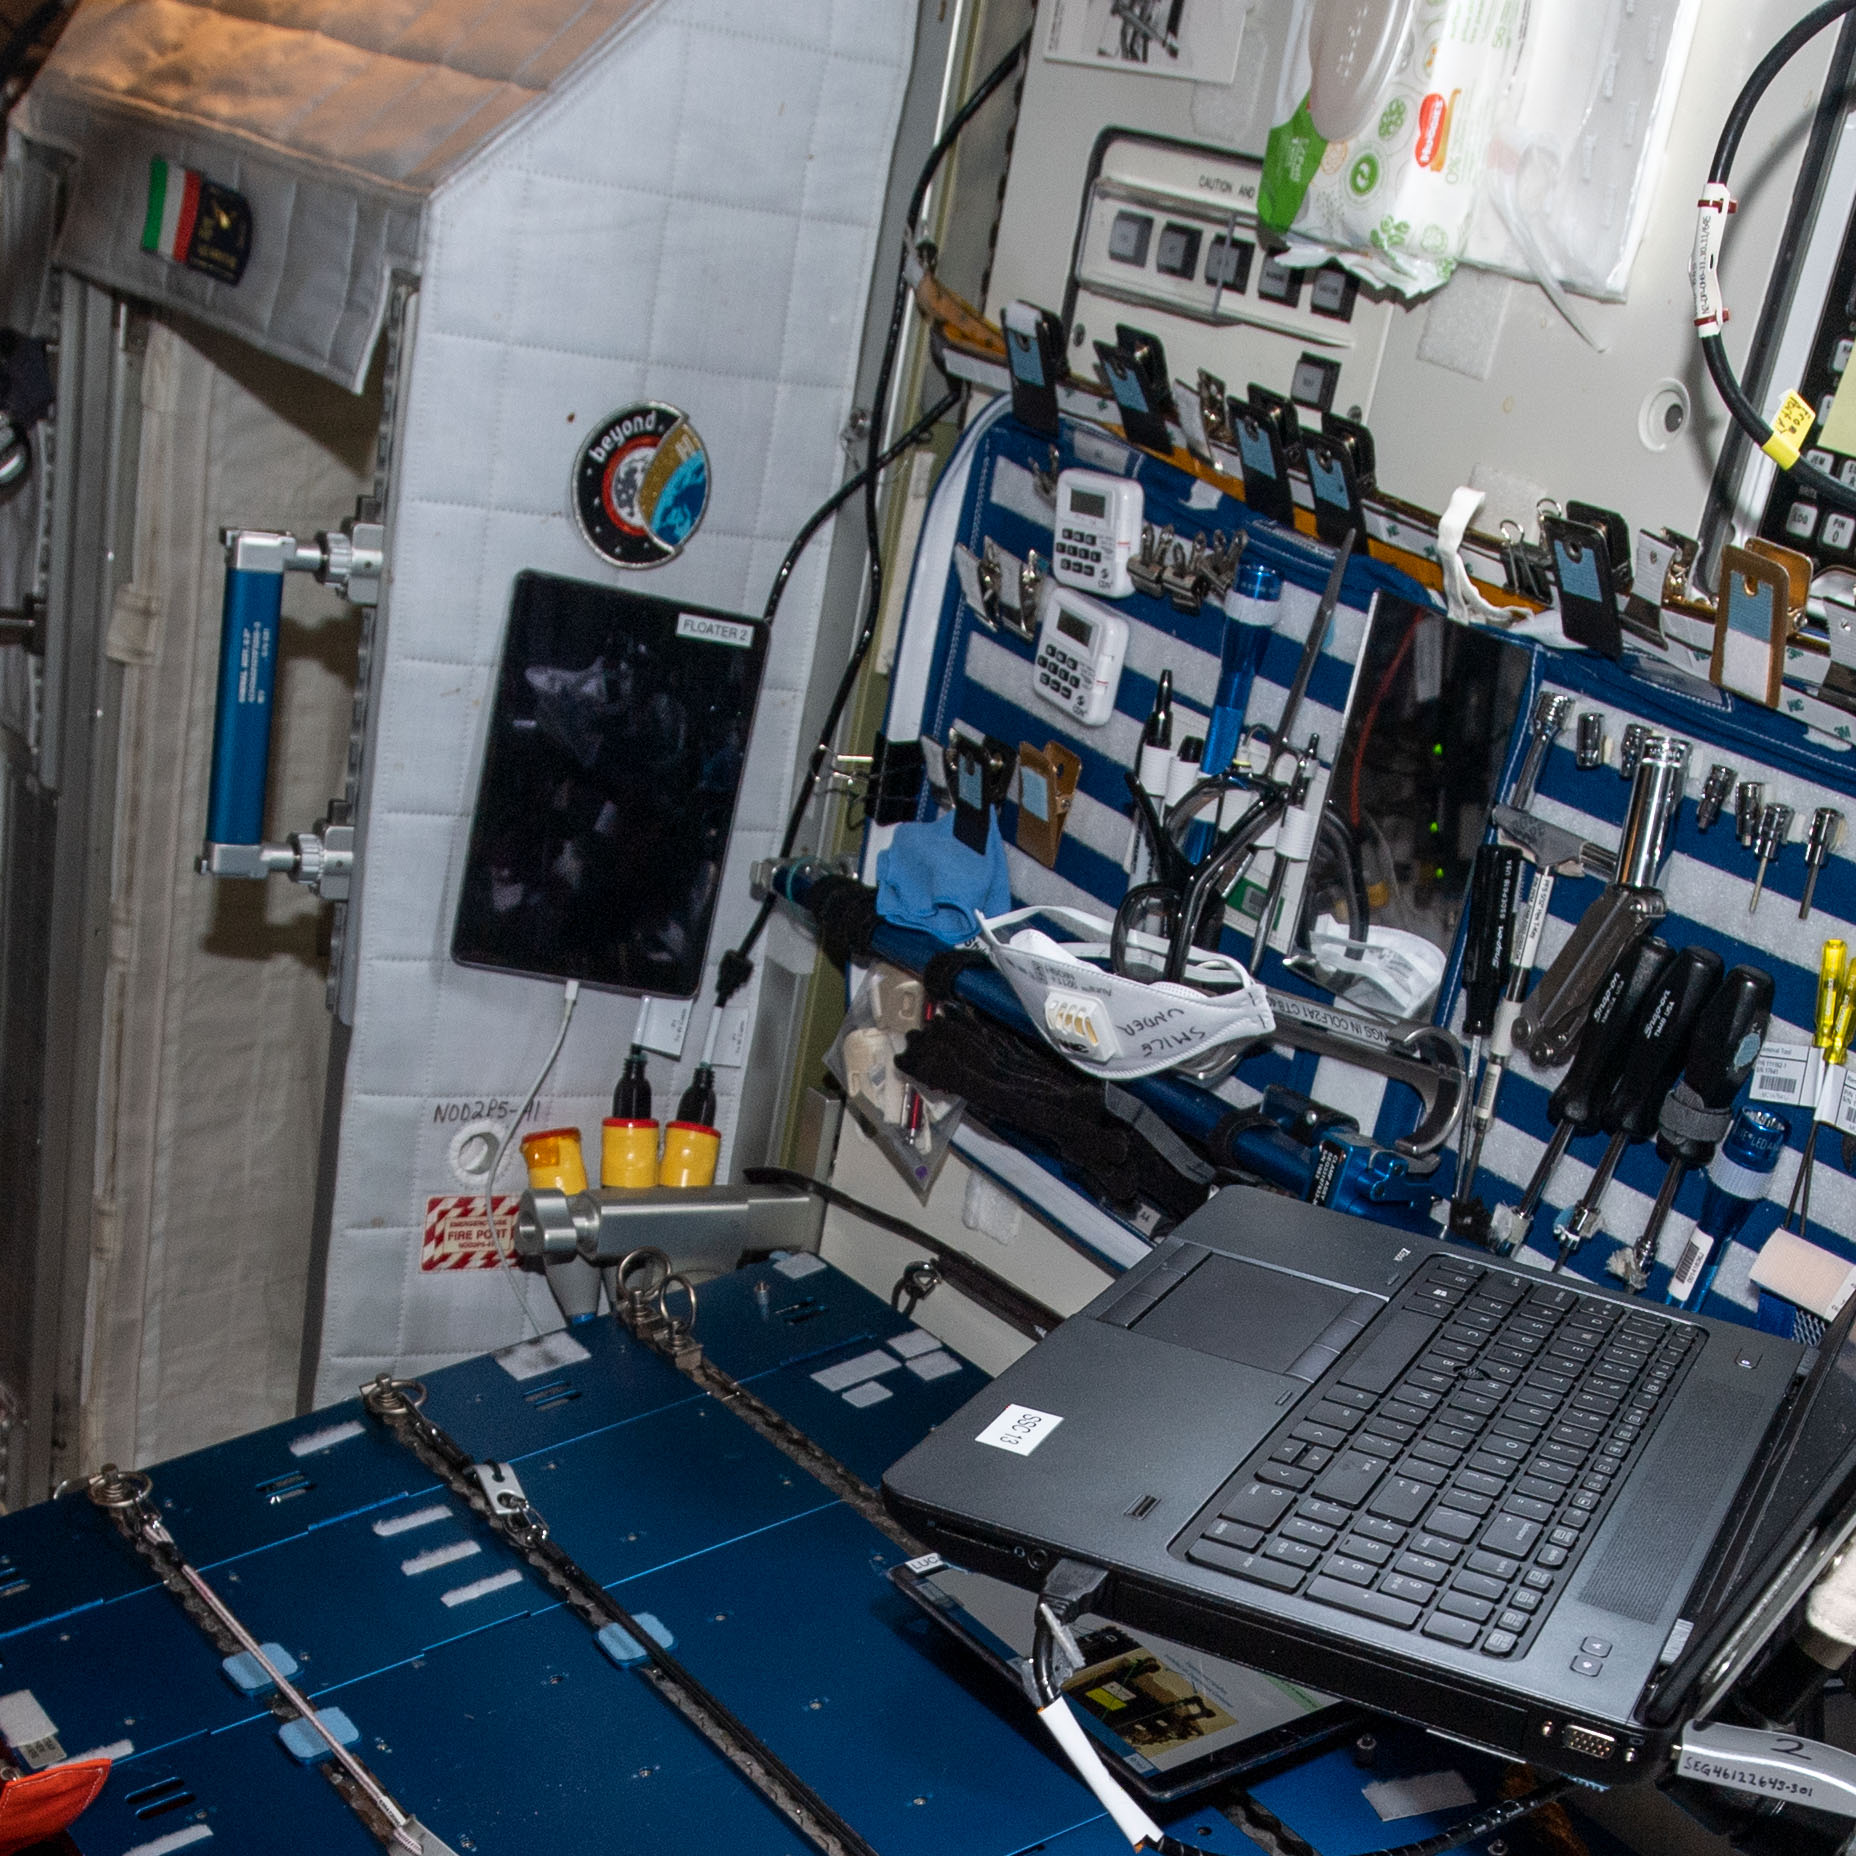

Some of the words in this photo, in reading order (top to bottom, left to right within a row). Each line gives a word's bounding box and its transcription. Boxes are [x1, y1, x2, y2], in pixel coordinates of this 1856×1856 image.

[1199, 175, 1232, 193] CAUTION
[1238, 183, 1254, 198] AND
[589, 410, 657, 463] beyond
[683, 618, 737, 640] FLOATER
[738, 629, 748, 641] 2
[1834, 725, 1852, 740] 3M
[1504, 859, 1513, 876] USA
[1593, 972, 1620, 1022] Snap-on
[1645, 989, 1672, 1040] Snap-on
[1665, 1001, 1675, 1019] USA
[1115, 1006, 1185, 1038] UNDER
[1348, 1020, 1364, 1035] IN
[1325, 1154, 1338, 1180] CLAMP
[1319, 1180, 1330, 1201] ASSY
[447, 1230, 473, 1241] FIRE
[1011, 1413, 1042, 1434] SSC
[1000, 1433, 1022, 1445] 13
[1770, 1738, 1812, 1761] 2
